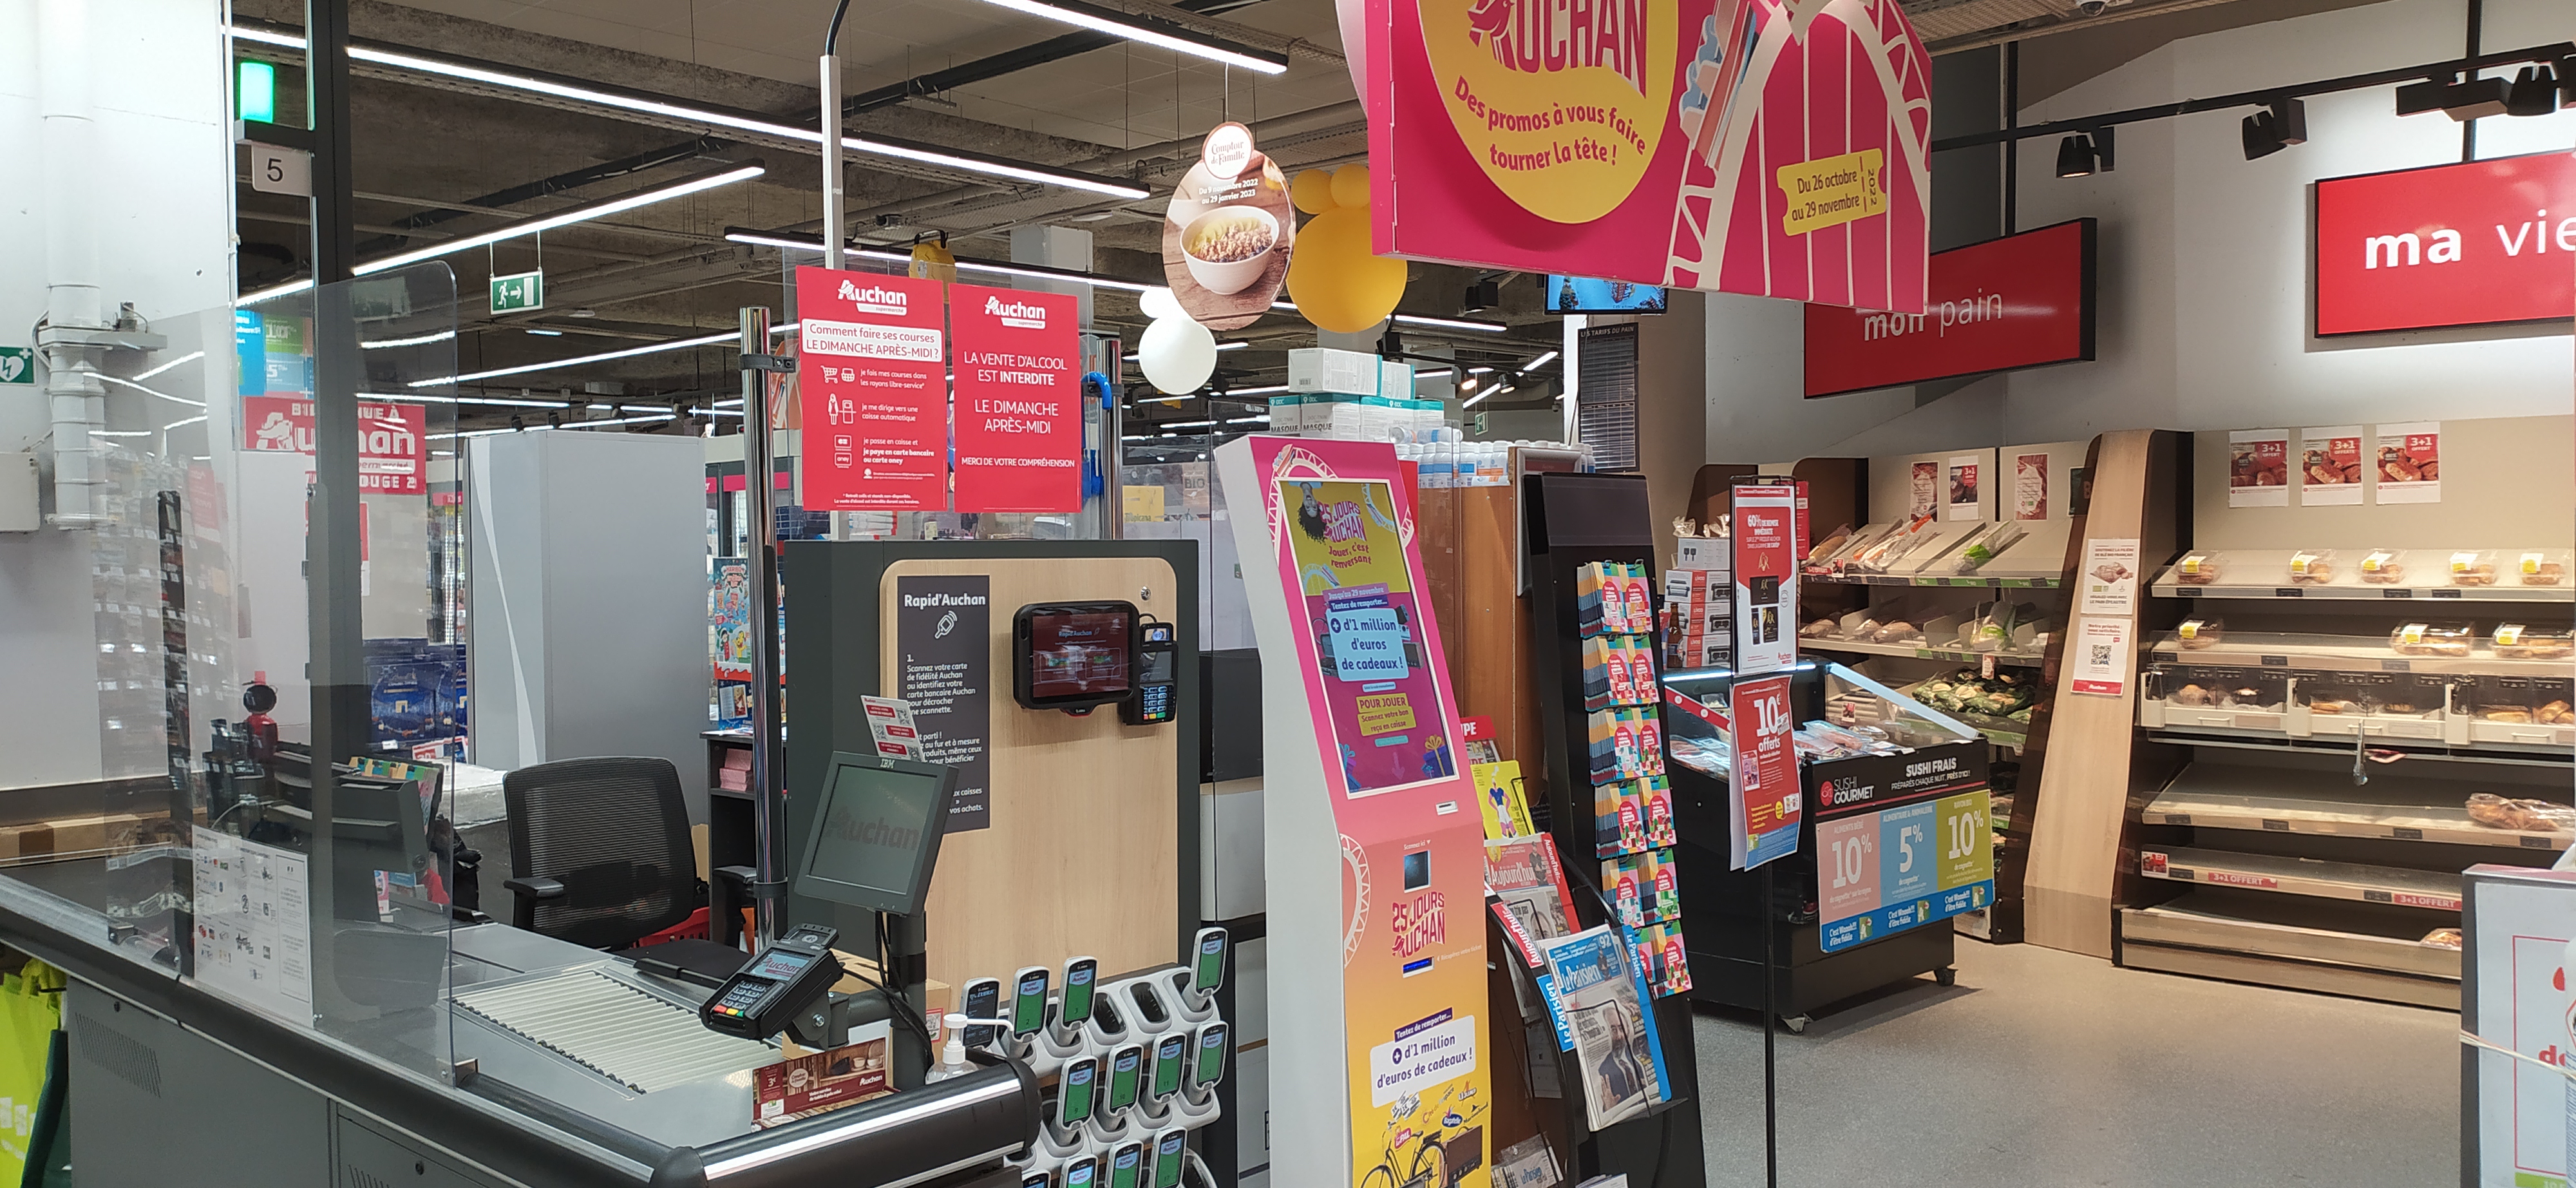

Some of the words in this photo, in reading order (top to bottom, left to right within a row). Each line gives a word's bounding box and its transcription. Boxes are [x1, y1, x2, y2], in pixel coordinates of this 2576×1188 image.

[1455, 75, 1485, 119] Des
[1488, 108, 1550, 131] promos
[1553, 102, 1563, 125] à
[1566, 106, 1604, 124] vous
[1609, 108, 1645, 155] faire
[1211, 141, 1244, 154] Comptoir
[1490, 144, 1550, 171] tourner
[1553, 142, 1571, 164] la
[1575, 137, 1607, 162] tête
[1218, 151, 1244, 166] Famille
[267, 159, 283, 182] 5
[1213, 182, 1242, 193] novembre
[1242, 178, 1258, 188] 2022
[1797, 178, 1811, 194] Du
[1812, 174, 1823, 191] 26
[1825, 169, 1857, 187] octobre
[1868, 169, 1877, 206] 2022
[1218, 192, 1239, 204] janvier
[1240, 189, 1255, 198] 2023
[1792, 209, 1804, 221] au
[1806, 202, 1816, 218] 29
[1818, 194, 1859, 215] novembre
[2366, 229, 2461, 269] ma
[838, 280, 906, 305] Auchan
[985, 296, 1045, 319] Auchan
[1864, 312, 1924, 341] mon
[1940, 287, 2002, 338] pain
[810, 324, 857, 337] Comment
[860, 328, 880, 340] faire
[883, 332, 897, 340] ses
[900, 332, 934, 343] courses
[807, 339, 818, 349] LE
[820, 340, 873, 354] DIMANCHE
[964, 351, 978, 364] LA
[980, 352, 1015, 367] VENTE
[1018, 355, 1067, 370] D'ALCOOL
[978, 370, 998, 382] EST
[1000, 371, 1054, 385] INTERDITE
[869, 381, 888, 390] rayons
[878, 404, 894, 413] dirige
[975, 399, 989, 412] LE
[994, 400, 1059, 416] DIMANCHE
[984, 416, 1050, 434] APRÈS-MIDI
[2262, 443, 2281, 452] 3+1
[2335, 441, 2355, 450] 3+1
[2410, 437, 2432, 446] 3+1
[961, 457, 982, 465] MERCI
[1018, 457, 1075, 467] COMPRÉHENSION
[1184, 478, 1205, 488] BIO
[1124, 514, 1151, 522] Tropicana
[1334, 501, 1360, 522] JOURS
[1329, 546, 1352, 557] Jouer,
[1352, 542, 1368, 553] c'est
[1331, 555, 1371, 568] renversant
[1359, 586, 1384, 596] novembre
[904, 593, 985, 609] Rapid'Auchan
[1331, 602, 1349, 610] Tentez
[1361, 618, 1396, 631] million
[1352, 638, 1387, 651] d'euros
[1341, 658, 1354, 670] de
[1356, 657, 1397, 670] cadeaux
[916, 681, 945, 689] identifiez
[923, 697, 953, 706] décrocher
[1359, 699, 1381, 709] POUR
[1383, 697, 1406, 707] JOUER
[1361, 713, 1384, 722] Scannez
[1385, 711, 1397, 720] votre
[1398, 709, 1408, 717] bon
[1390, 720, 1406, 729] caisse
[923, 732, 938, 741] parti
[1759, 736, 1780, 752] offerts
[880, 759, 895, 769] IBM
[1906, 763, 1931, 777] SUSHI
[1933, 758, 1956, 772] FRAIS
[1834, 776, 1857, 791] SUSHI
[1891, 780, 1915, 790] PRÉPARÉS
[1915, 776, 1934, 786] CHAQUE
[961, 787, 982, 796] caisses
[1834, 786, 1874, 804] GOURMET
[961, 804, 983, 812] achats.
[824, 807, 920, 851] Auchan
[1948, 810, 1984, 859] 10%
[1900, 823, 1923, 873] 5%
[1832, 834, 1872, 888] 10%
[2213, 873, 2230, 883] 3+1
[2231, 876, 2263, 886] OFFERT
[2400, 895, 2418, 905] 3+1
[2420, 897, 2455, 908] OFFERT
[1392, 902, 1407, 932] 25
[1409, 892, 1444, 926] JOURS
[1392, 911, 1445, 958] AUCHAN
[1599, 935, 1611, 948] 92
[1627, 934, 1633, 944] Le
[1471, 944, 1482, 953] ticket
[1629, 943, 1641, 977] Parisien
[1546, 982, 1566, 1031] Parisien
[1396, 1028, 1414, 1039] Tentez
[1414, 1022, 1421, 1031] de
[1561, 1032, 1571, 1043] Le
[1421, 1034, 1455, 1055] million
[1377, 1070, 1412, 1089] d'euros
[1414, 1063, 1426, 1077] de
[1428, 1051, 1468, 1072] cadeaux
[859, 1075, 883, 1086] Auchan
